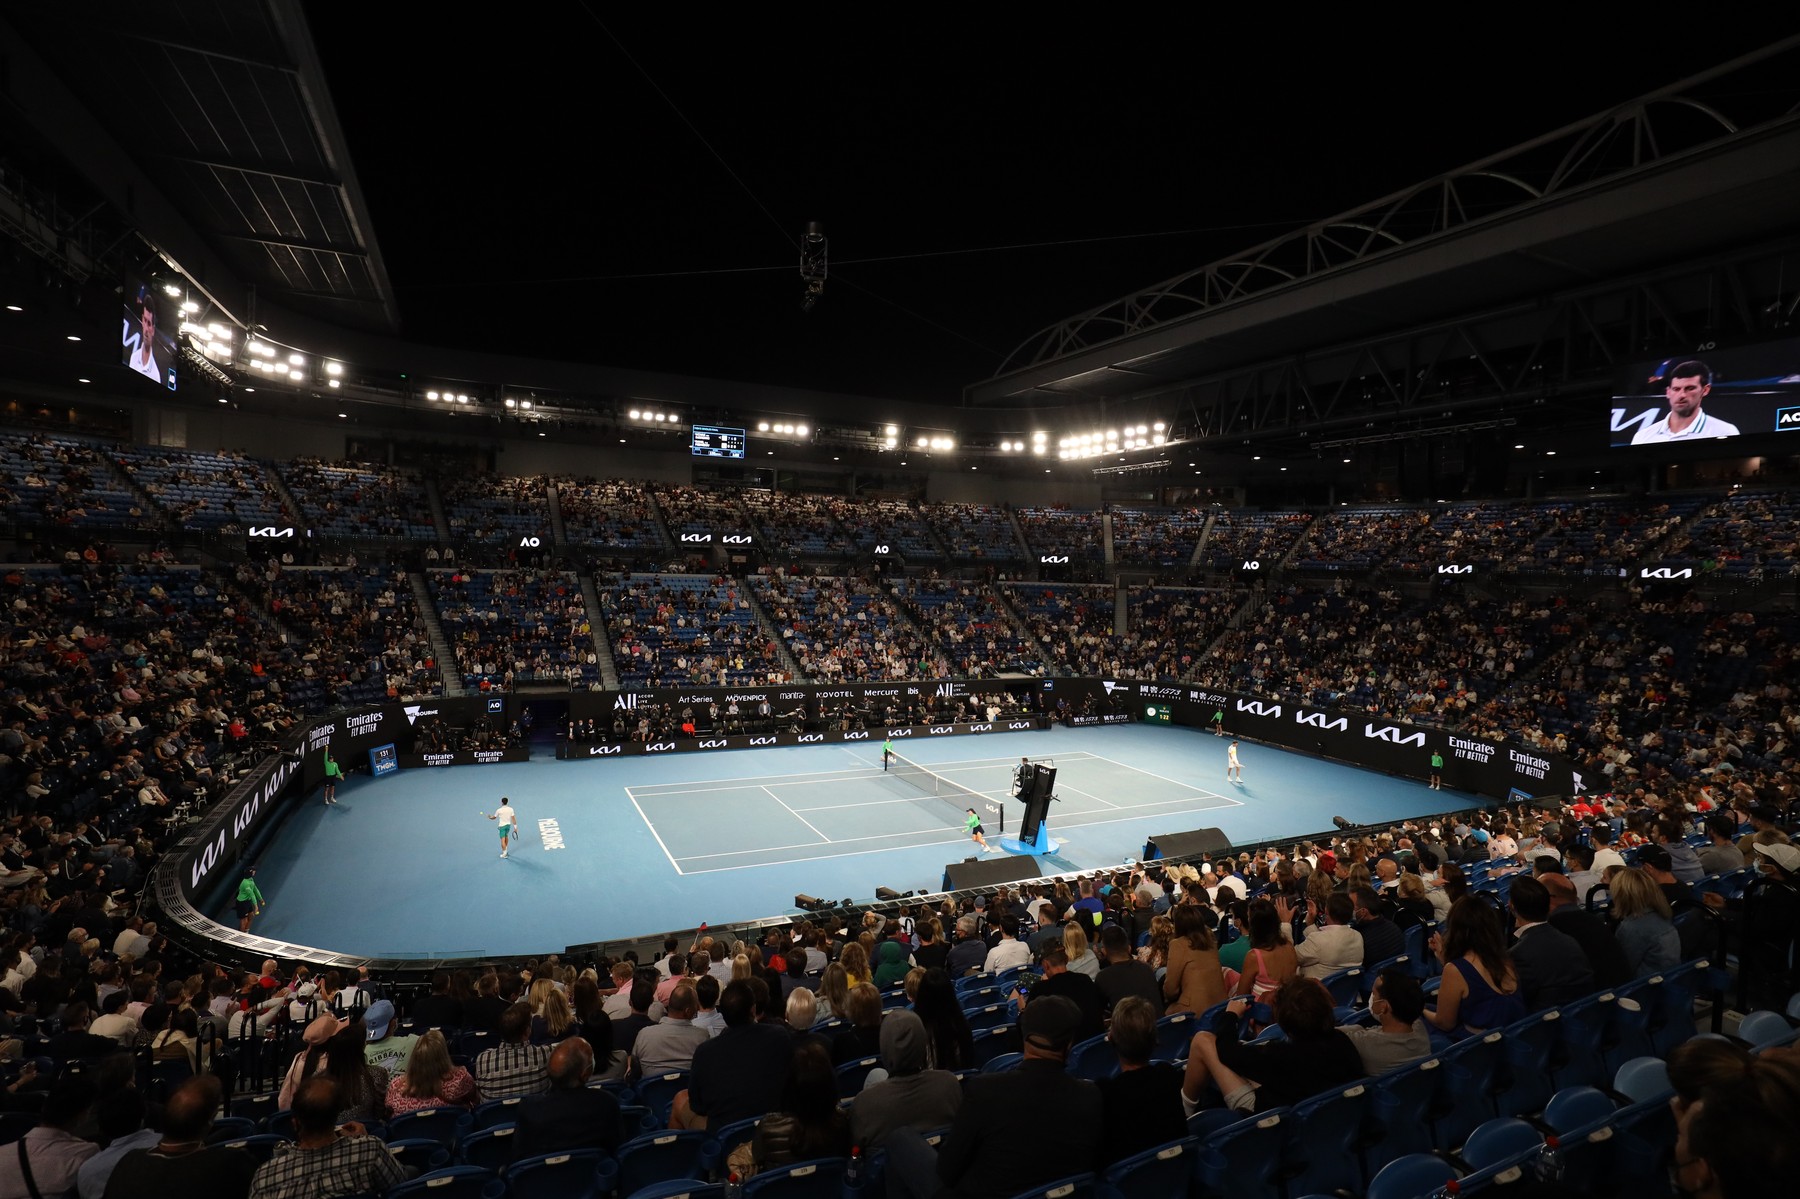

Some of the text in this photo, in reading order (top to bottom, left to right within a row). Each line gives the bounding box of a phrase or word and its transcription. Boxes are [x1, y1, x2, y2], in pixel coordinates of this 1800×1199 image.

[1697, 341, 1716, 351] AO
[1780, 413, 1800, 424] AO
[519, 537, 540, 547] AO
[874, 545, 890, 554] AO
[1243, 561, 1260, 570] AO
[779, 691, 806, 700] mantra
[816, 691, 854, 699] NOVOTEL
[864, 688, 899, 697] Mercure
[907, 687, 919, 695] ibis
[1158, 687, 1182, 696] 1573
[678, 695, 713, 704] Art Series
[725, 694, 767, 702] MÖVENPICK
[1207, 694, 1227, 703] 1573
[346, 711, 383, 729] Emirates
[309, 723, 335, 742] Emirates
[358, 722, 377, 735] BETTER
[315, 735, 331, 749] BETTER
[1448, 736, 1495, 756] Emirates
[380, 749, 389, 758] 131
[423, 753, 454, 761] Emirates
[1455, 749, 1489, 764] FLY BETTER
[1509, 749, 1551, 771] Emirates
[1515, 763, 1545, 780] FLY BETTER
[368, 1051, 406, 1064] RIBBEAN
